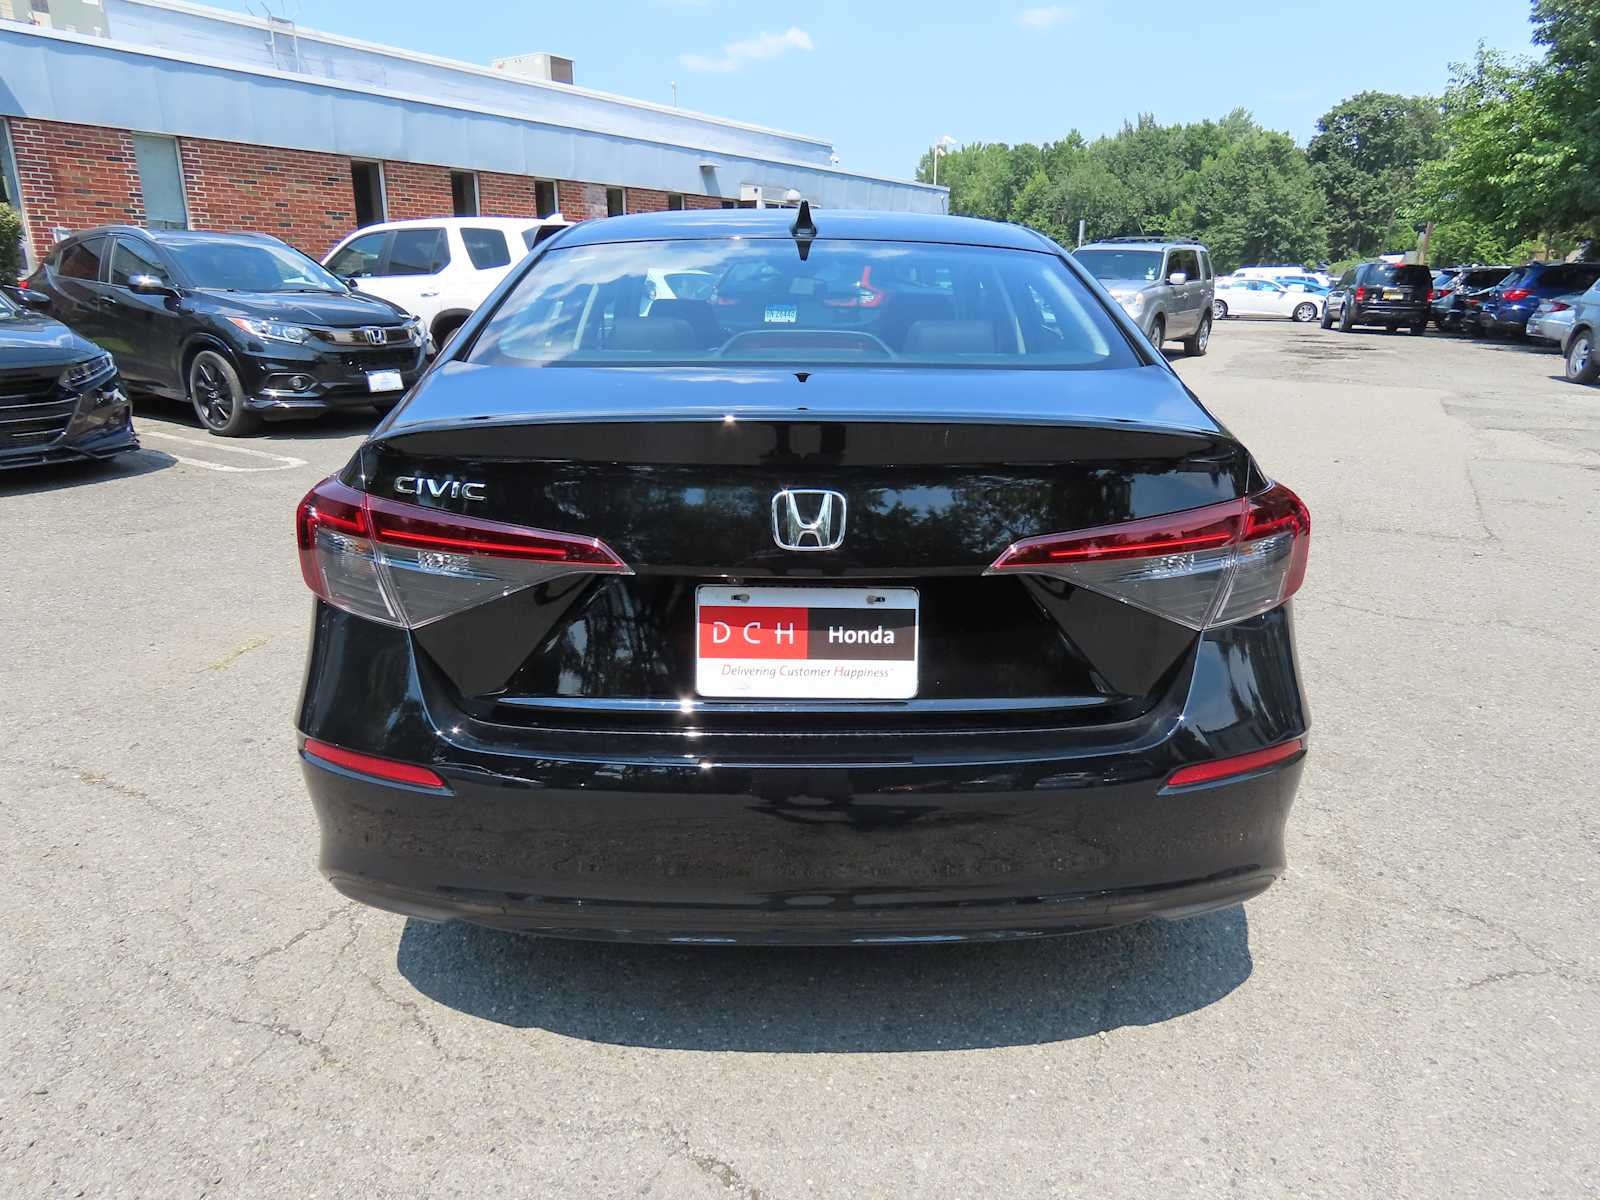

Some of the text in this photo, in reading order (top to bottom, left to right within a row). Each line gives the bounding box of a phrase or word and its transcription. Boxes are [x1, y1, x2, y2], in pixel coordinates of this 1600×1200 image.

[394, 476, 487, 501] CIVIC
[828, 625, 895, 644] Honda
[721, 664, 889, 679] Delivering Customer Happiness
